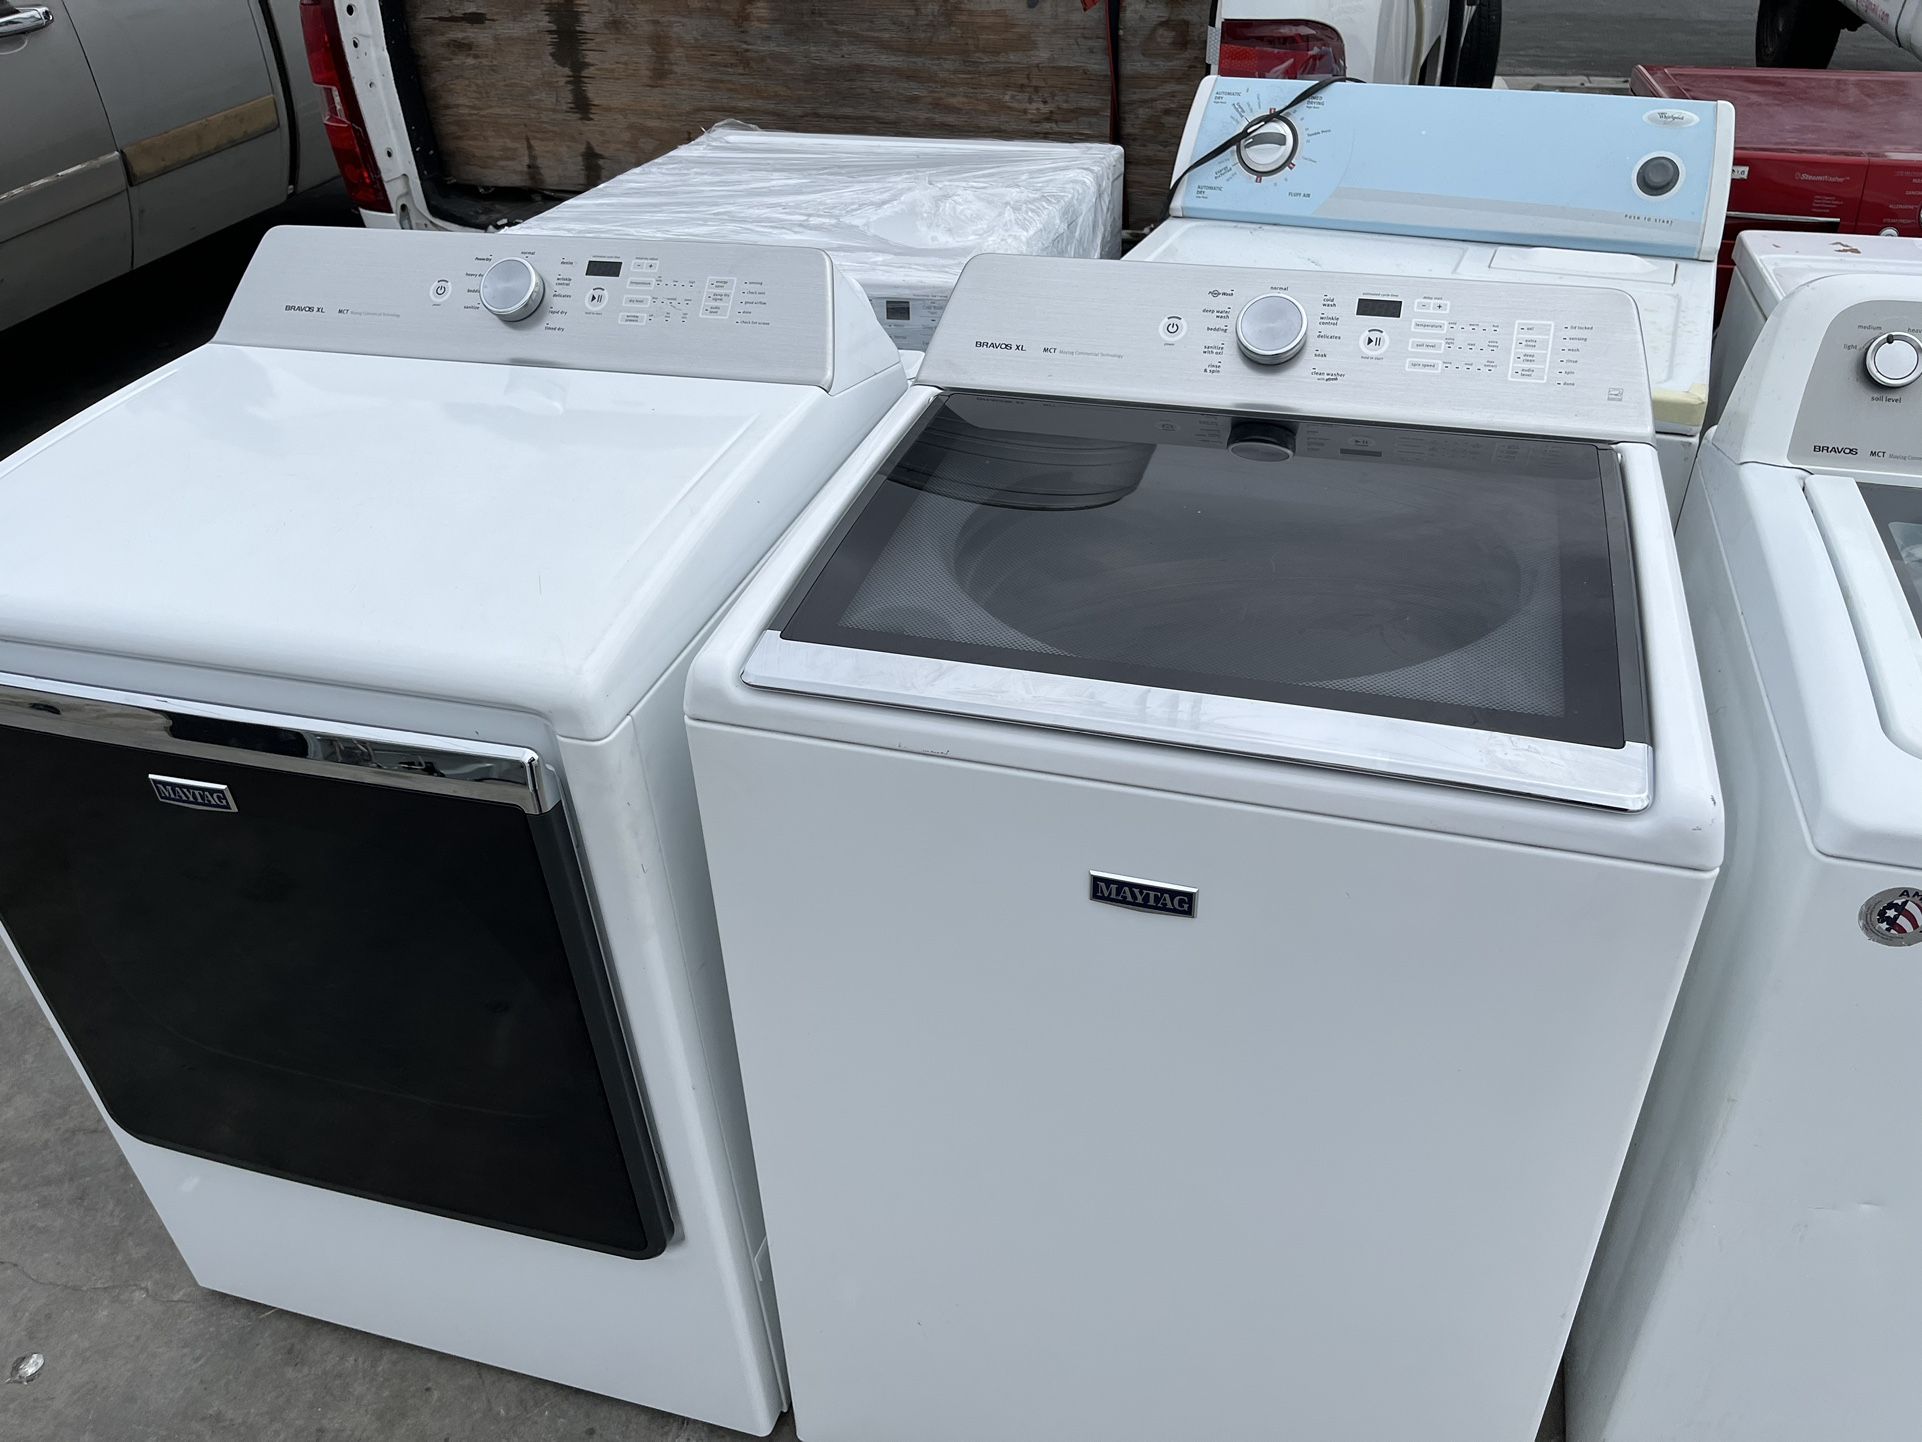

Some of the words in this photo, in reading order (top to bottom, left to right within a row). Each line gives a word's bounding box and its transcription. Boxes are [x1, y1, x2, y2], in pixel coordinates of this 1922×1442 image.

[1657, 112, 1685, 122] Whirlpool
[285, 304, 315, 313] BRAVOS
[975, 340, 1013, 351] BRAVOS
[1015, 344, 1027, 352] XL
[1844, 343, 1858, 351] light
[1885, 396, 1902, 404] level
[1813, 445, 1858, 456] BRAVOS
[1870, 450, 1887, 458] MCT
[155, 783, 228, 806] MAYTAG
[1096, 881, 1190, 912] MAYTAG
